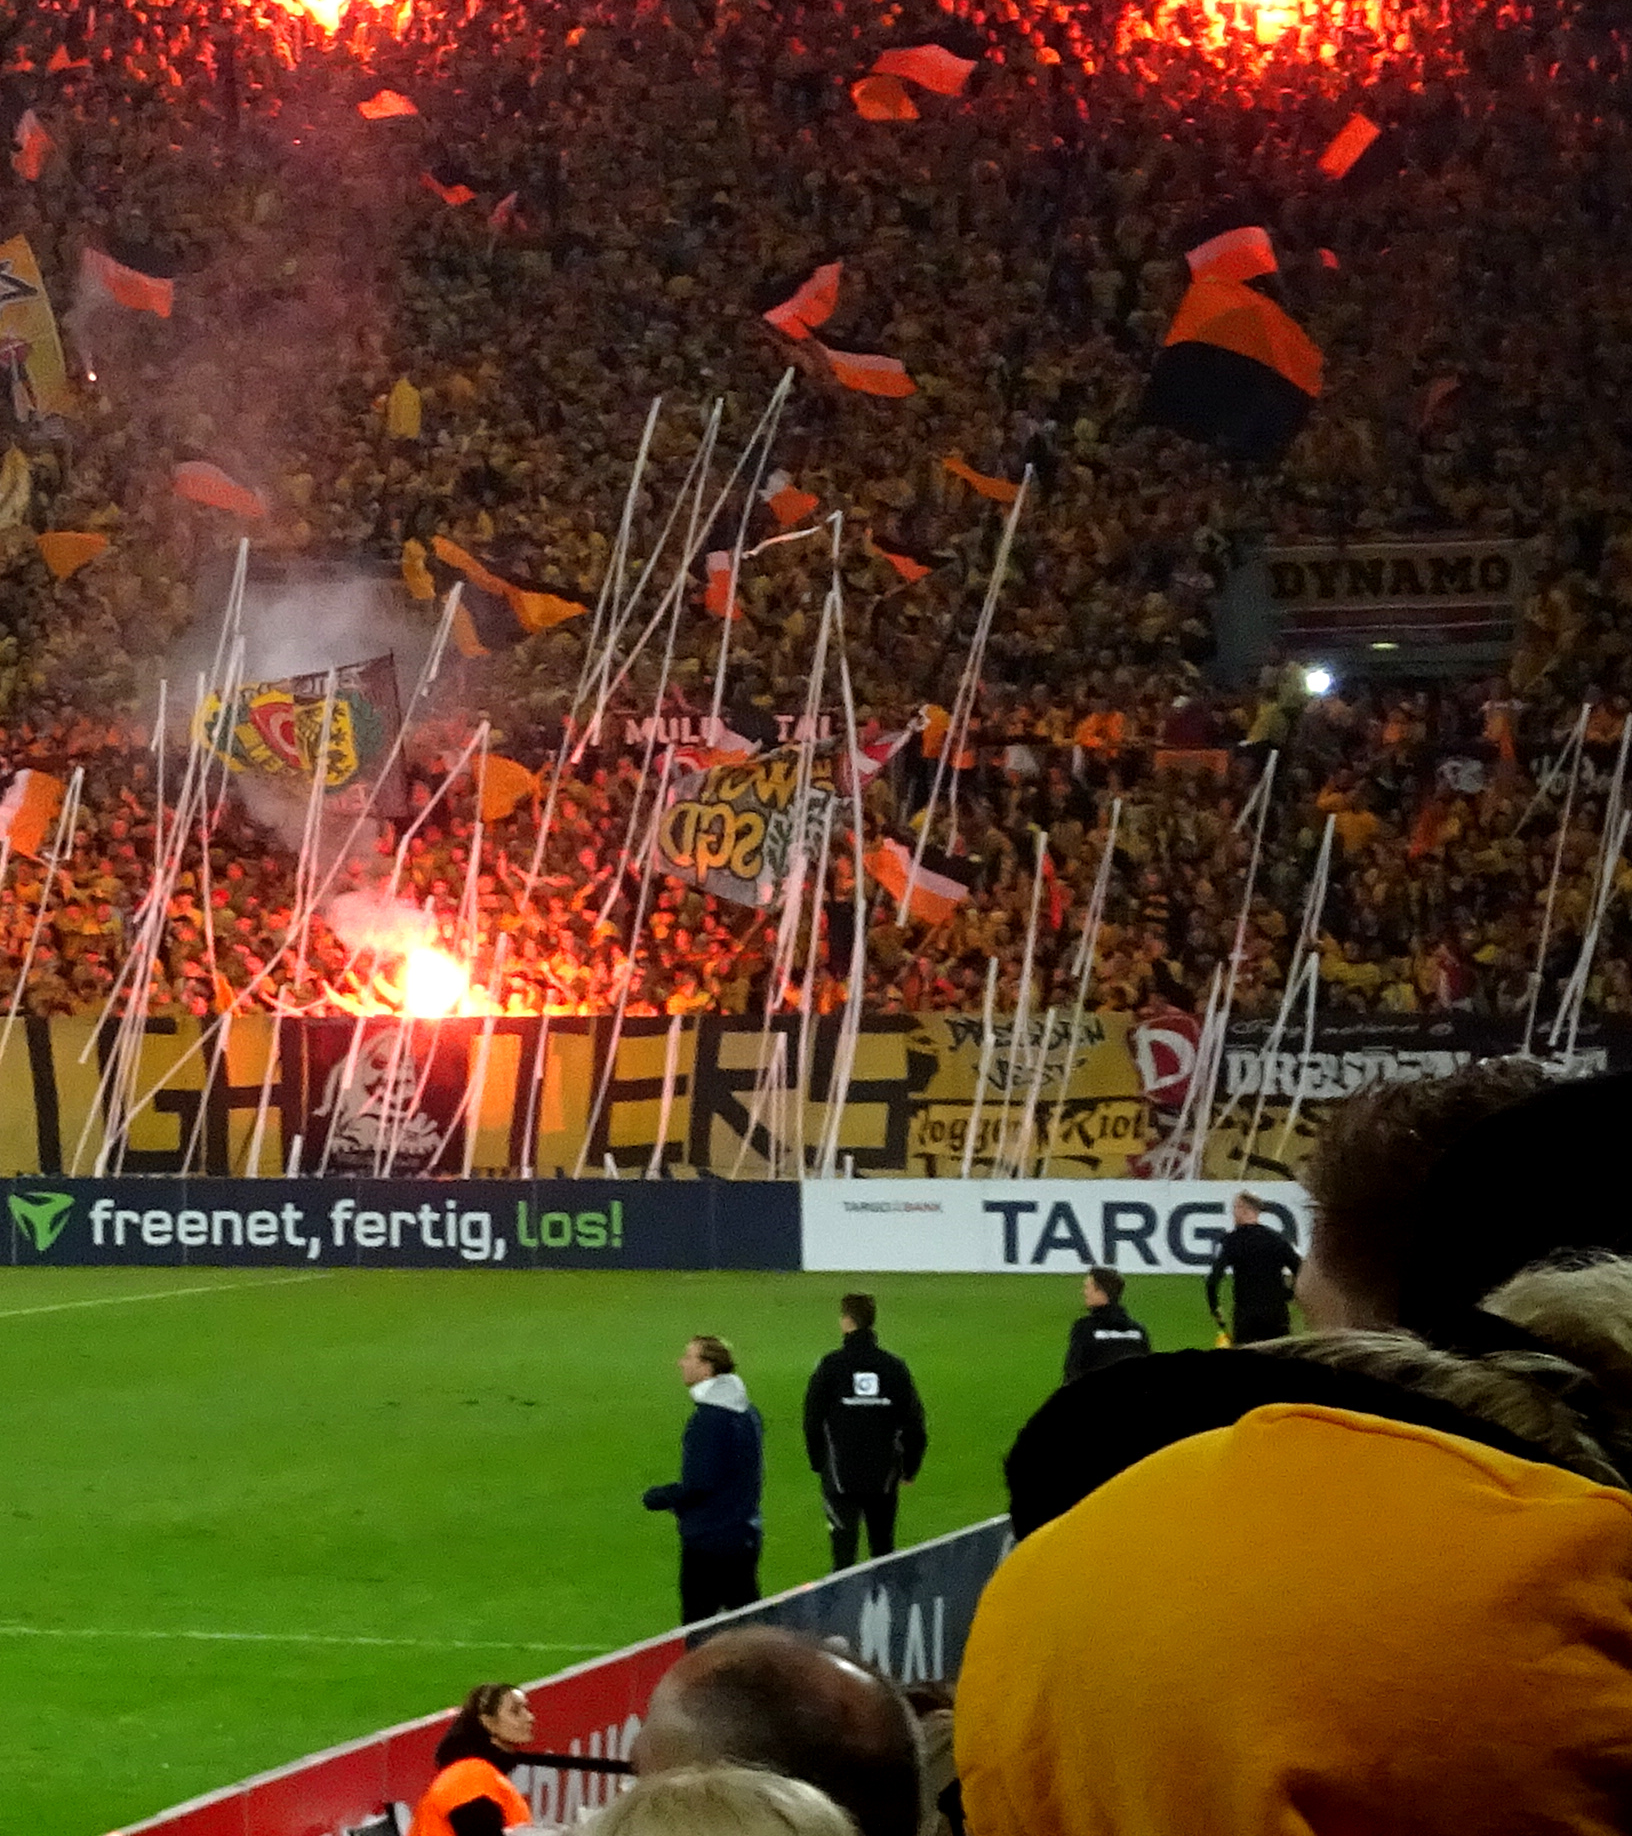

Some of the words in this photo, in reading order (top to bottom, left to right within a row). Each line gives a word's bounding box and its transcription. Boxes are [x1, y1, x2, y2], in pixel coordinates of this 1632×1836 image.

[1270, 554, 1512, 599] DYNAMO
[89, 1198, 321, 1259] freenet,
[330, 1198, 507, 1261] fertig,
[516, 1199, 624, 1248] los!
